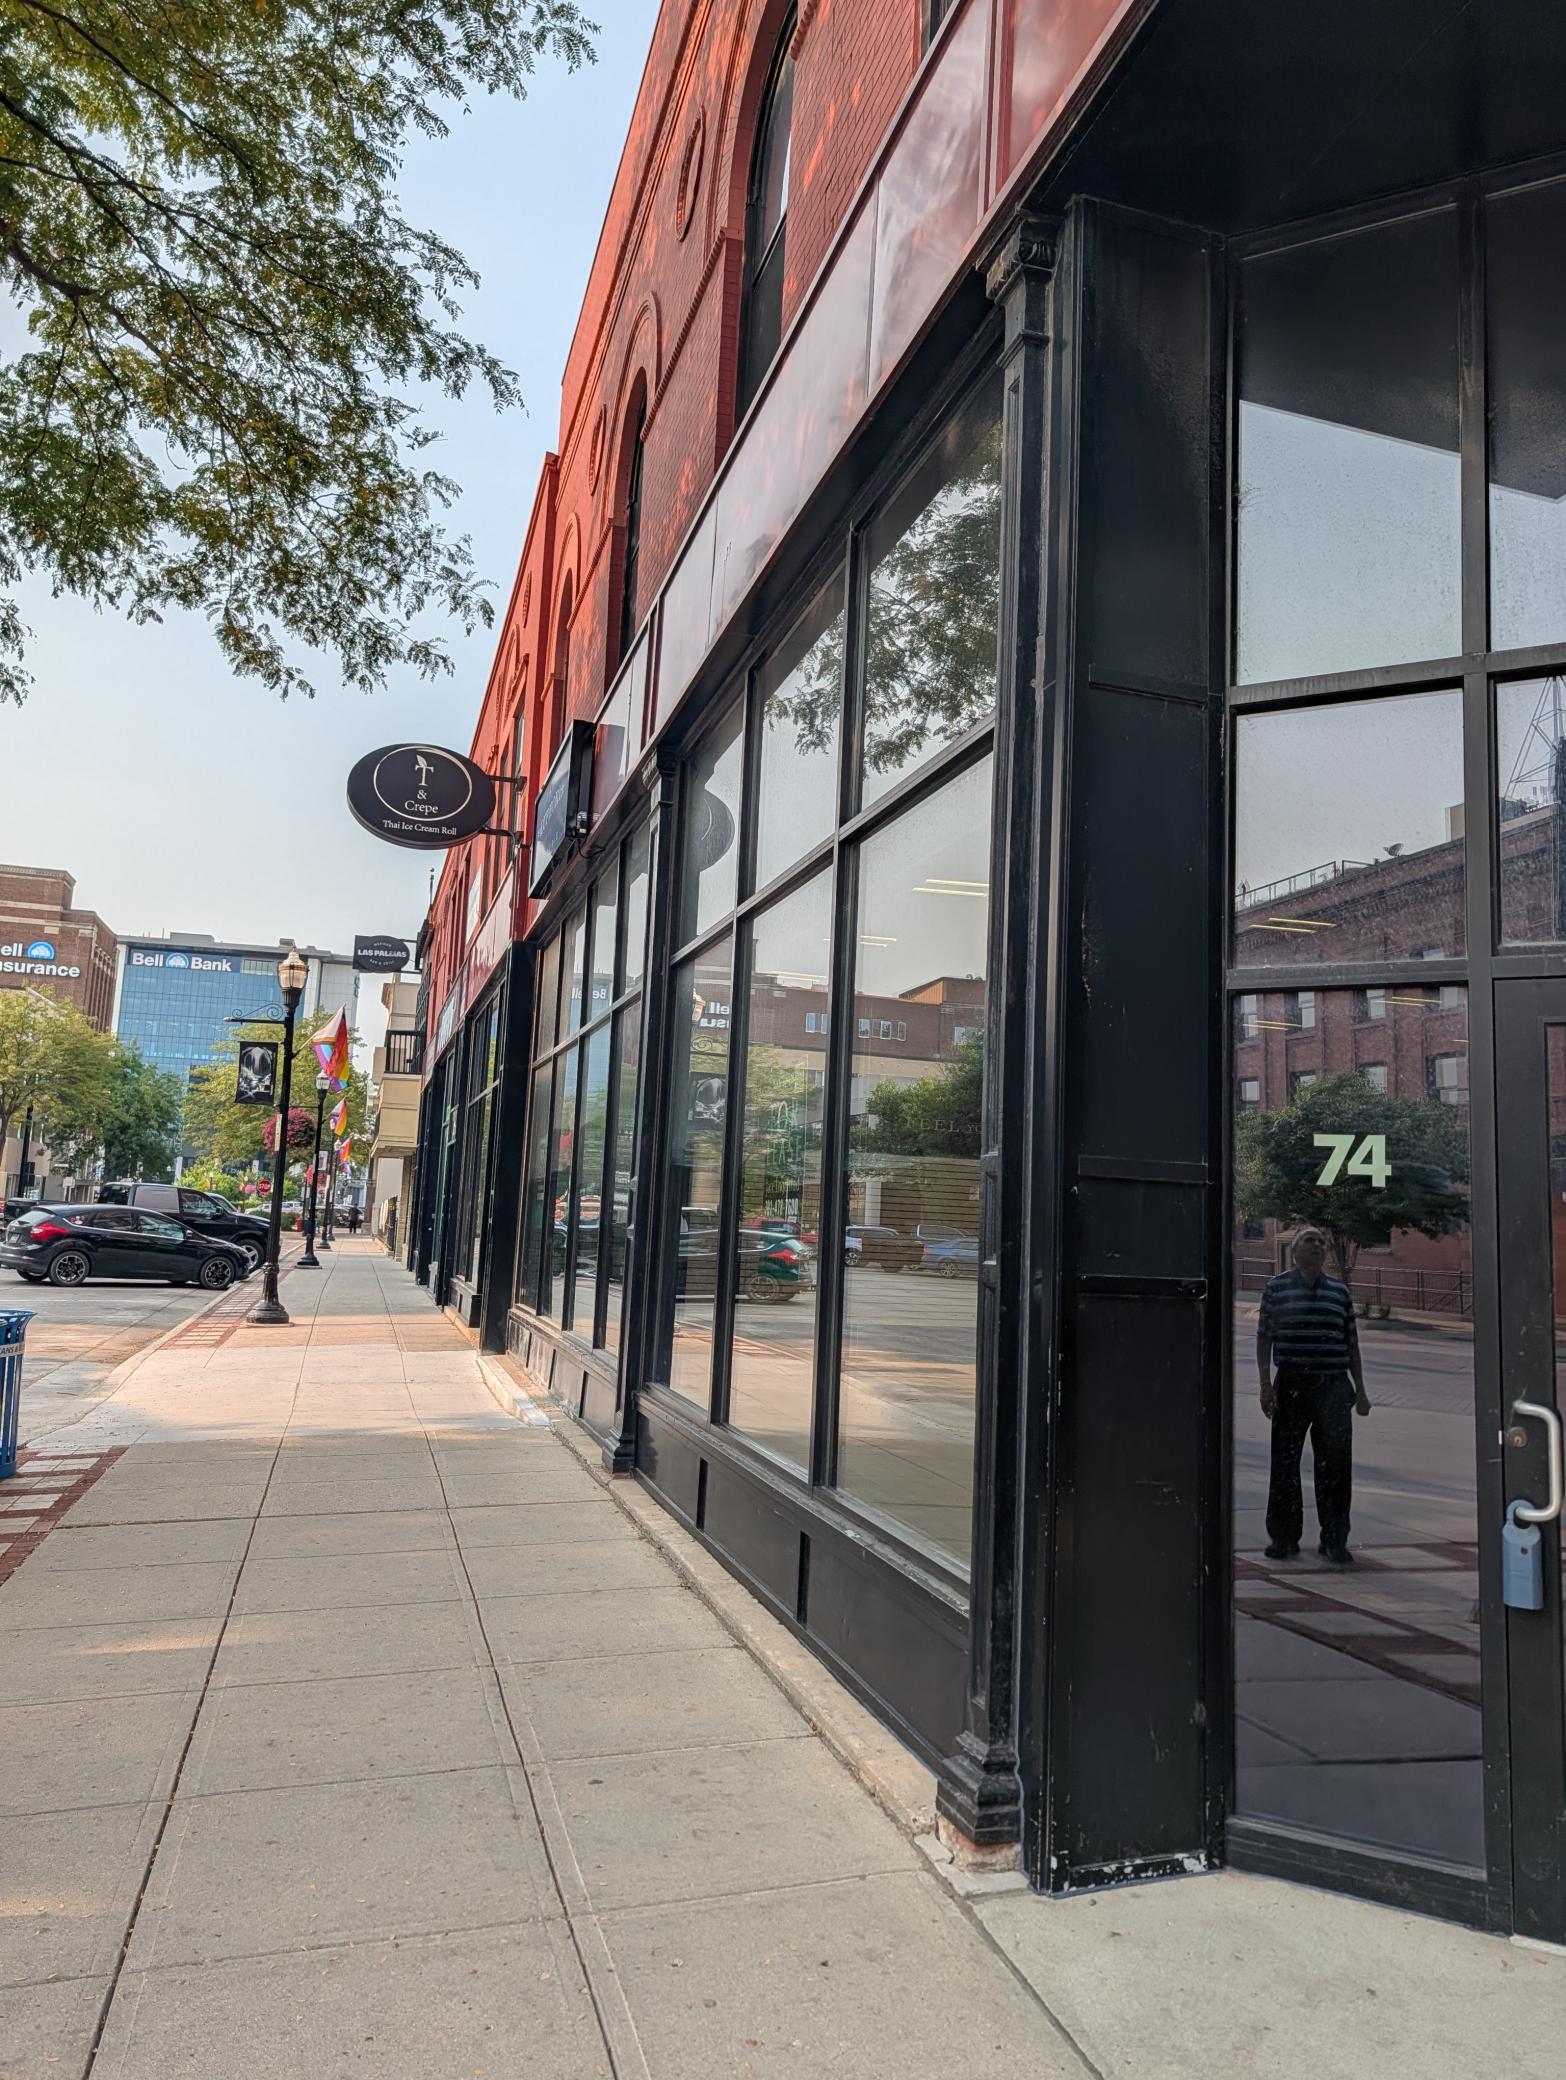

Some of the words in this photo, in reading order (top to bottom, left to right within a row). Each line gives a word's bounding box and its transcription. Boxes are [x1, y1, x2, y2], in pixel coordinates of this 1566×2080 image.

[417, 789, 427, 800] &
[404, 800, 439, 815] Crepe
[383, 820, 400, 829] Thai
[401, 821, 413, 831] Ice
[414, 823, 440, 834] Cream
[441, 826, 457, 836] Roll
[0, 943, 23, 957] ell
[0, 961, 80, 977] surance
[132, 952, 164, 967] Bell
[190, 956, 232, 972] Bank
[1313, 1134, 1392, 1187] 74
